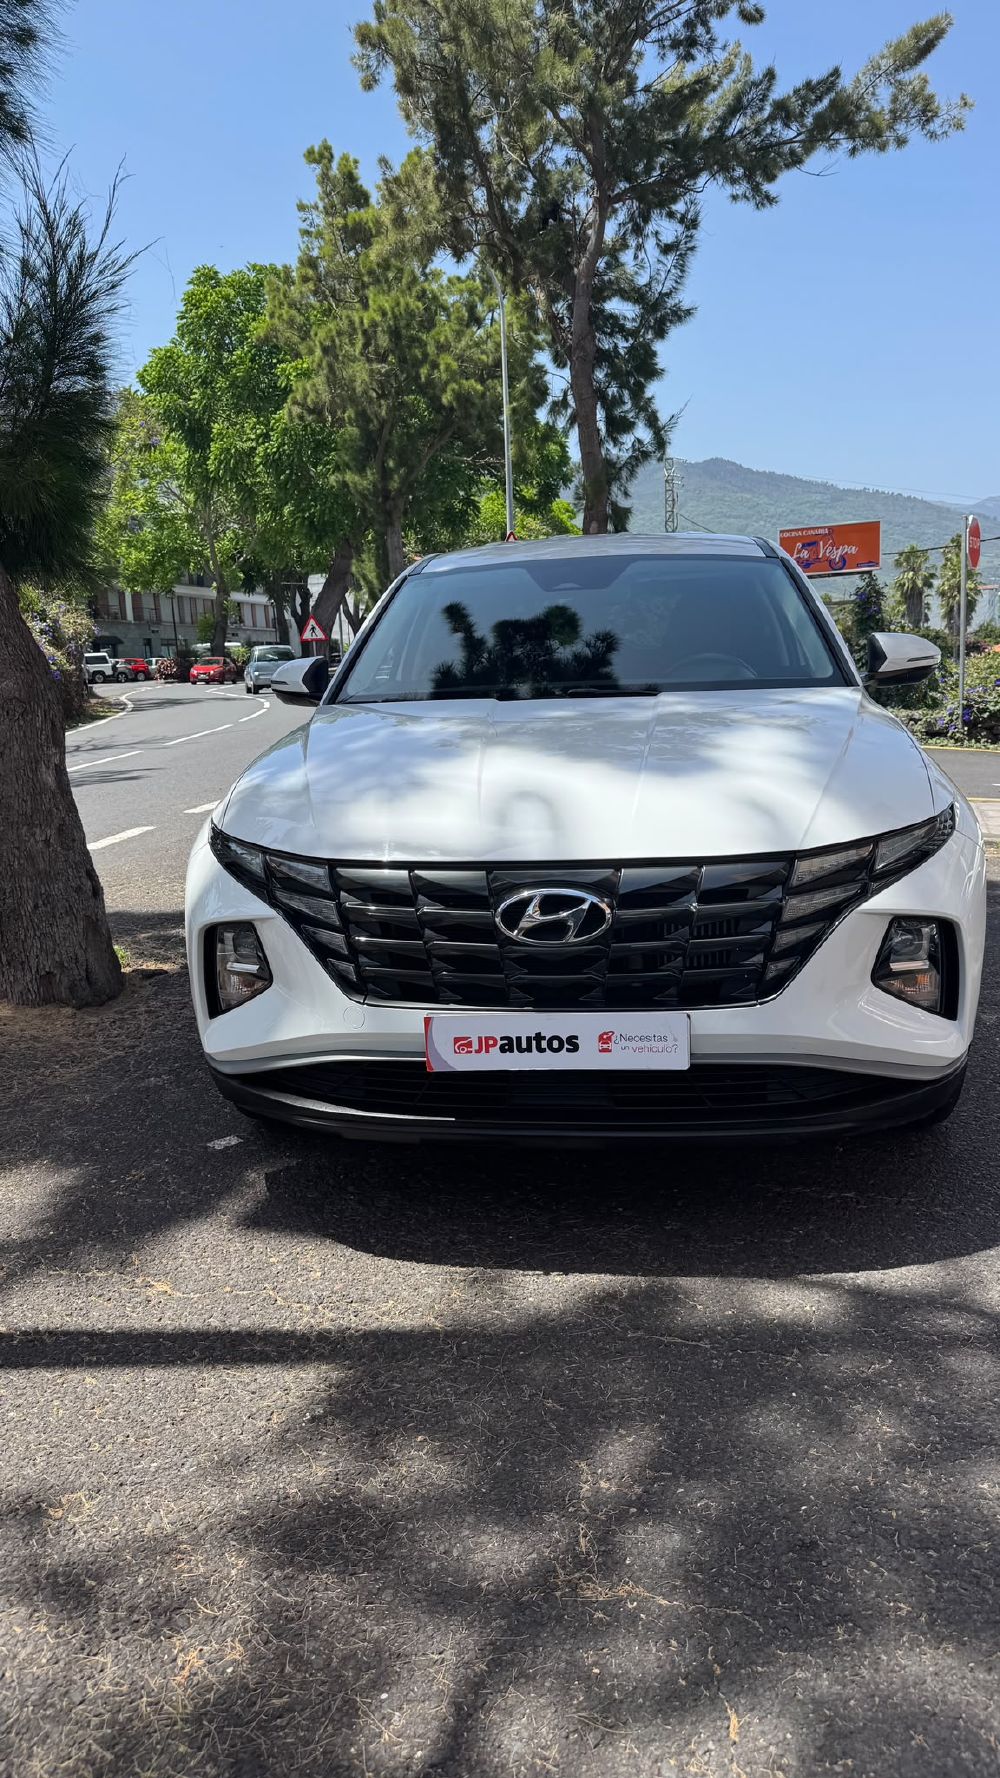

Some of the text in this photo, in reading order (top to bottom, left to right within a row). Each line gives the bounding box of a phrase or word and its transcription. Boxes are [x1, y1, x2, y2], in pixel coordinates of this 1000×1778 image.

[792, 539, 859, 564] La Vespa
[614, 1033, 669, 1045] ¿Necesitas
